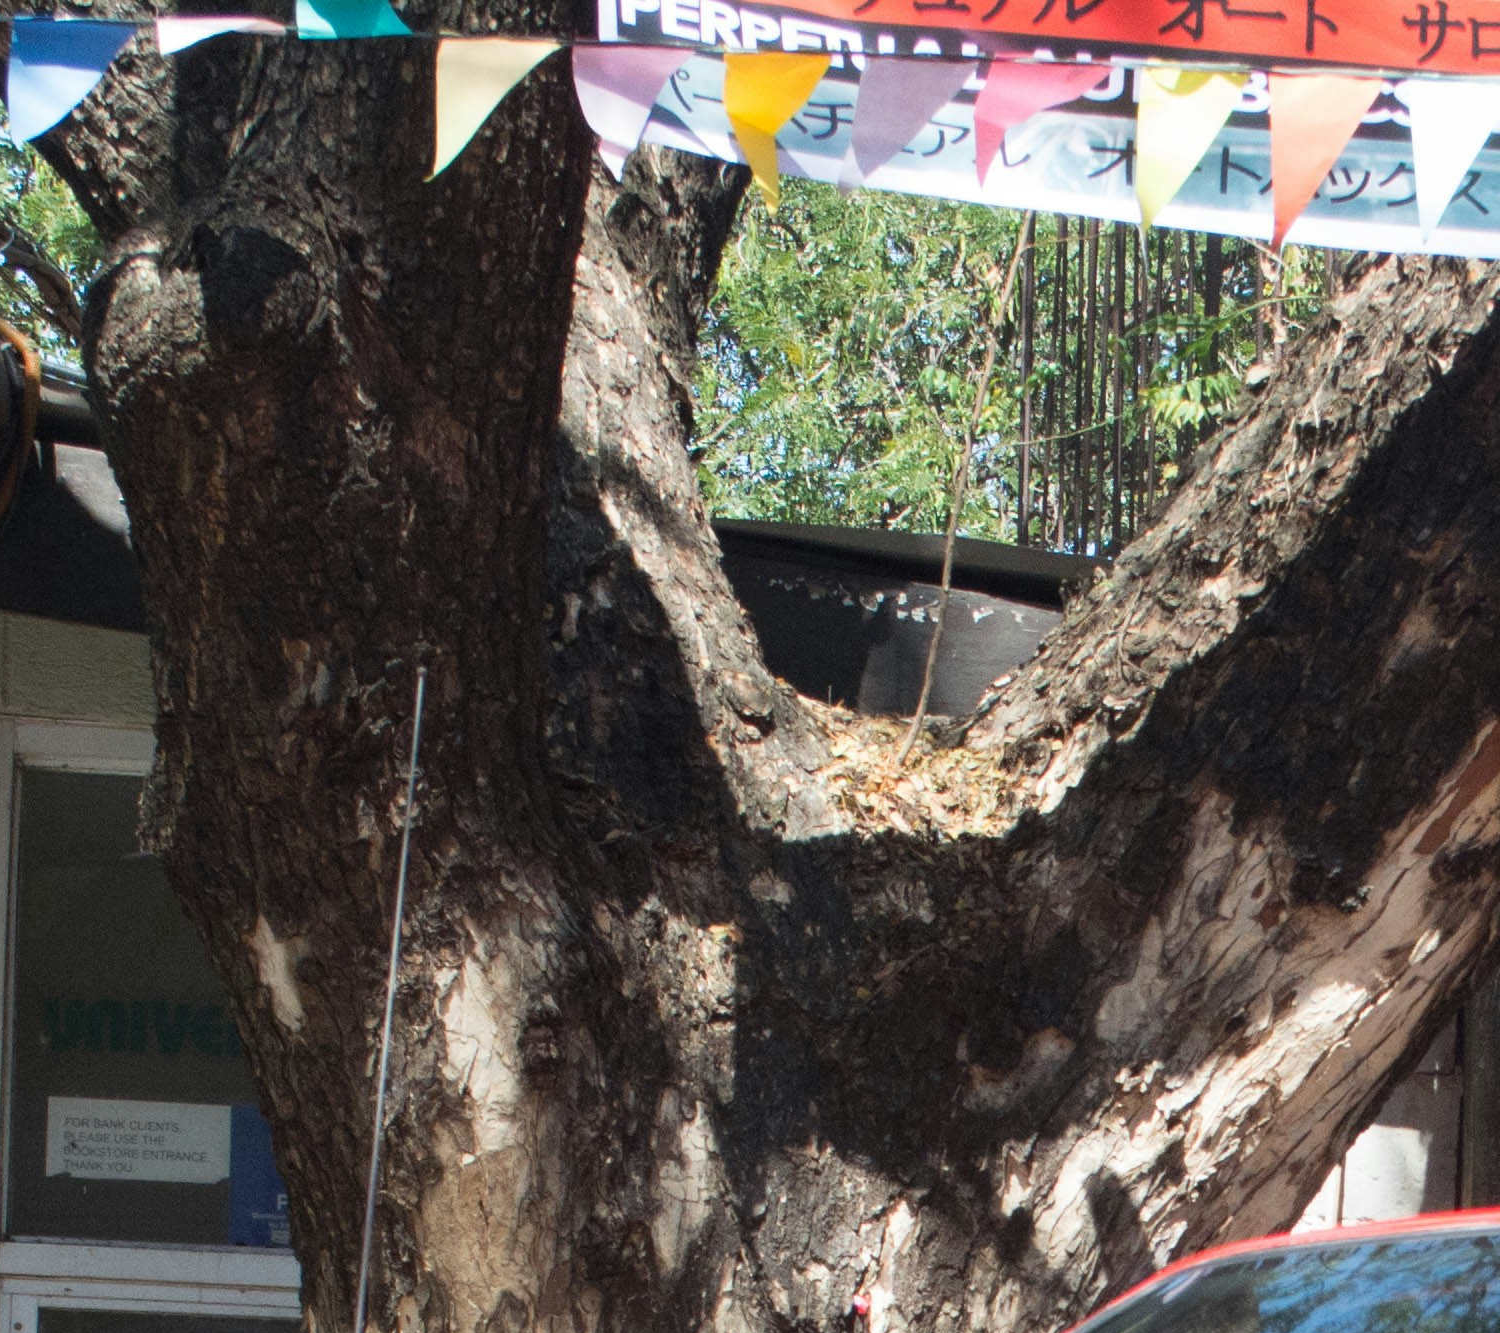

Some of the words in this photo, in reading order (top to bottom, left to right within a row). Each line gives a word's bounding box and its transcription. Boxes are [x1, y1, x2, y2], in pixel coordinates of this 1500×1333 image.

[63, 1116, 90, 1129] FOR
[93, 1118, 125, 1131] BANK
[63, 1131, 111, 1144] PLEASE
[114, 1133, 138, 1145] USE
[143, 1134, 165, 1146] THE
[63, 1145, 140, 1160] BOOKSTORE
[63, 1158, 103, 1171] THANK
